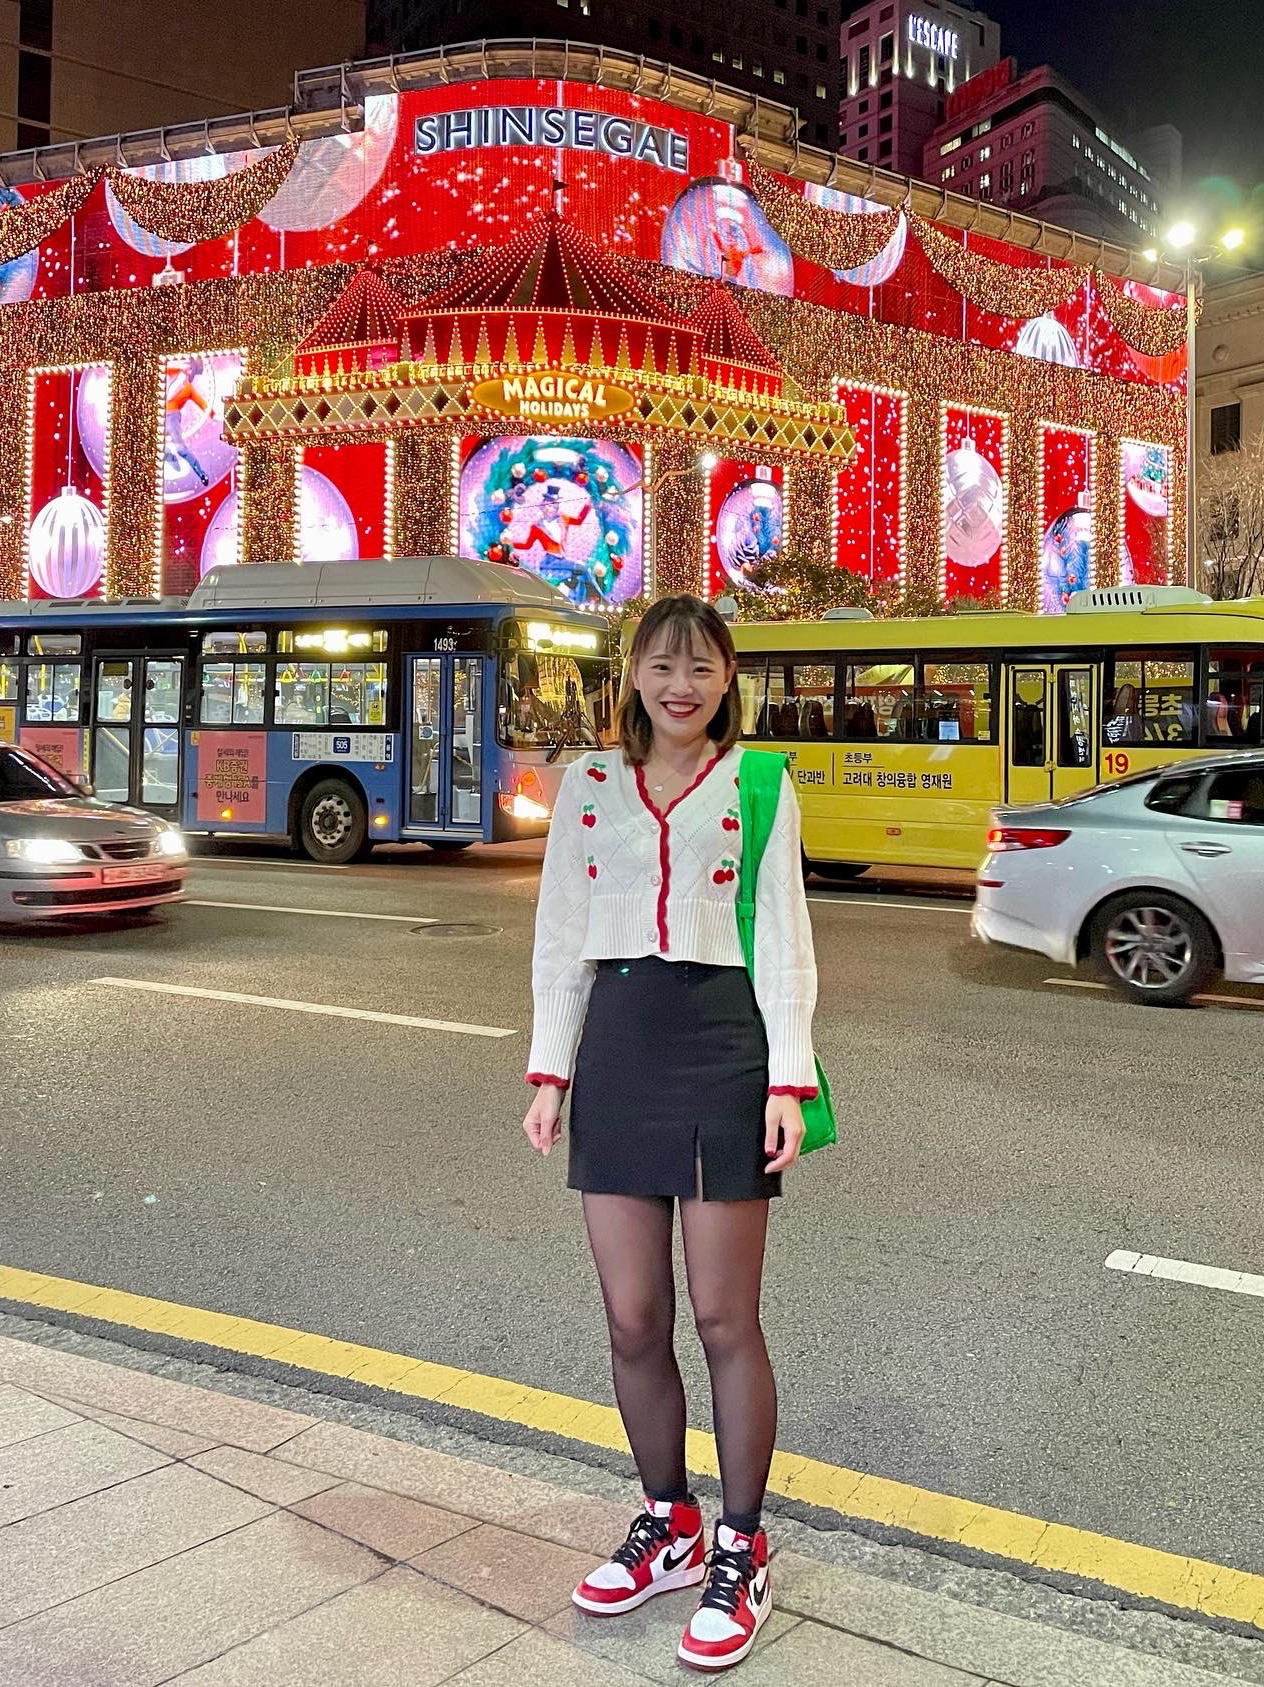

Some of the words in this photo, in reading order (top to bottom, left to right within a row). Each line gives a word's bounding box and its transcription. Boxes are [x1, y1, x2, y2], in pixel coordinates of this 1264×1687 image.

[907, 14, 958, 59] L'ESCAPE
[416, 108, 687, 172] SHINSEGAE
[503, 376, 607, 407] MAGICAL
[520, 400, 589, 418] HOLIDAYS
[336, 741, 348, 750] 505
[216, 759, 248, 774] KB증권
[844, 752, 873, 764] 초등부
[1105, 753, 1129, 774] 19
[797, 770, 825, 784] 단과반
[843, 772, 873, 786] 고려대
[876, 772, 917, 788] 창의융합
[920, 773, 953, 789] 영재원
[216, 791, 250, 803] 만나세요
